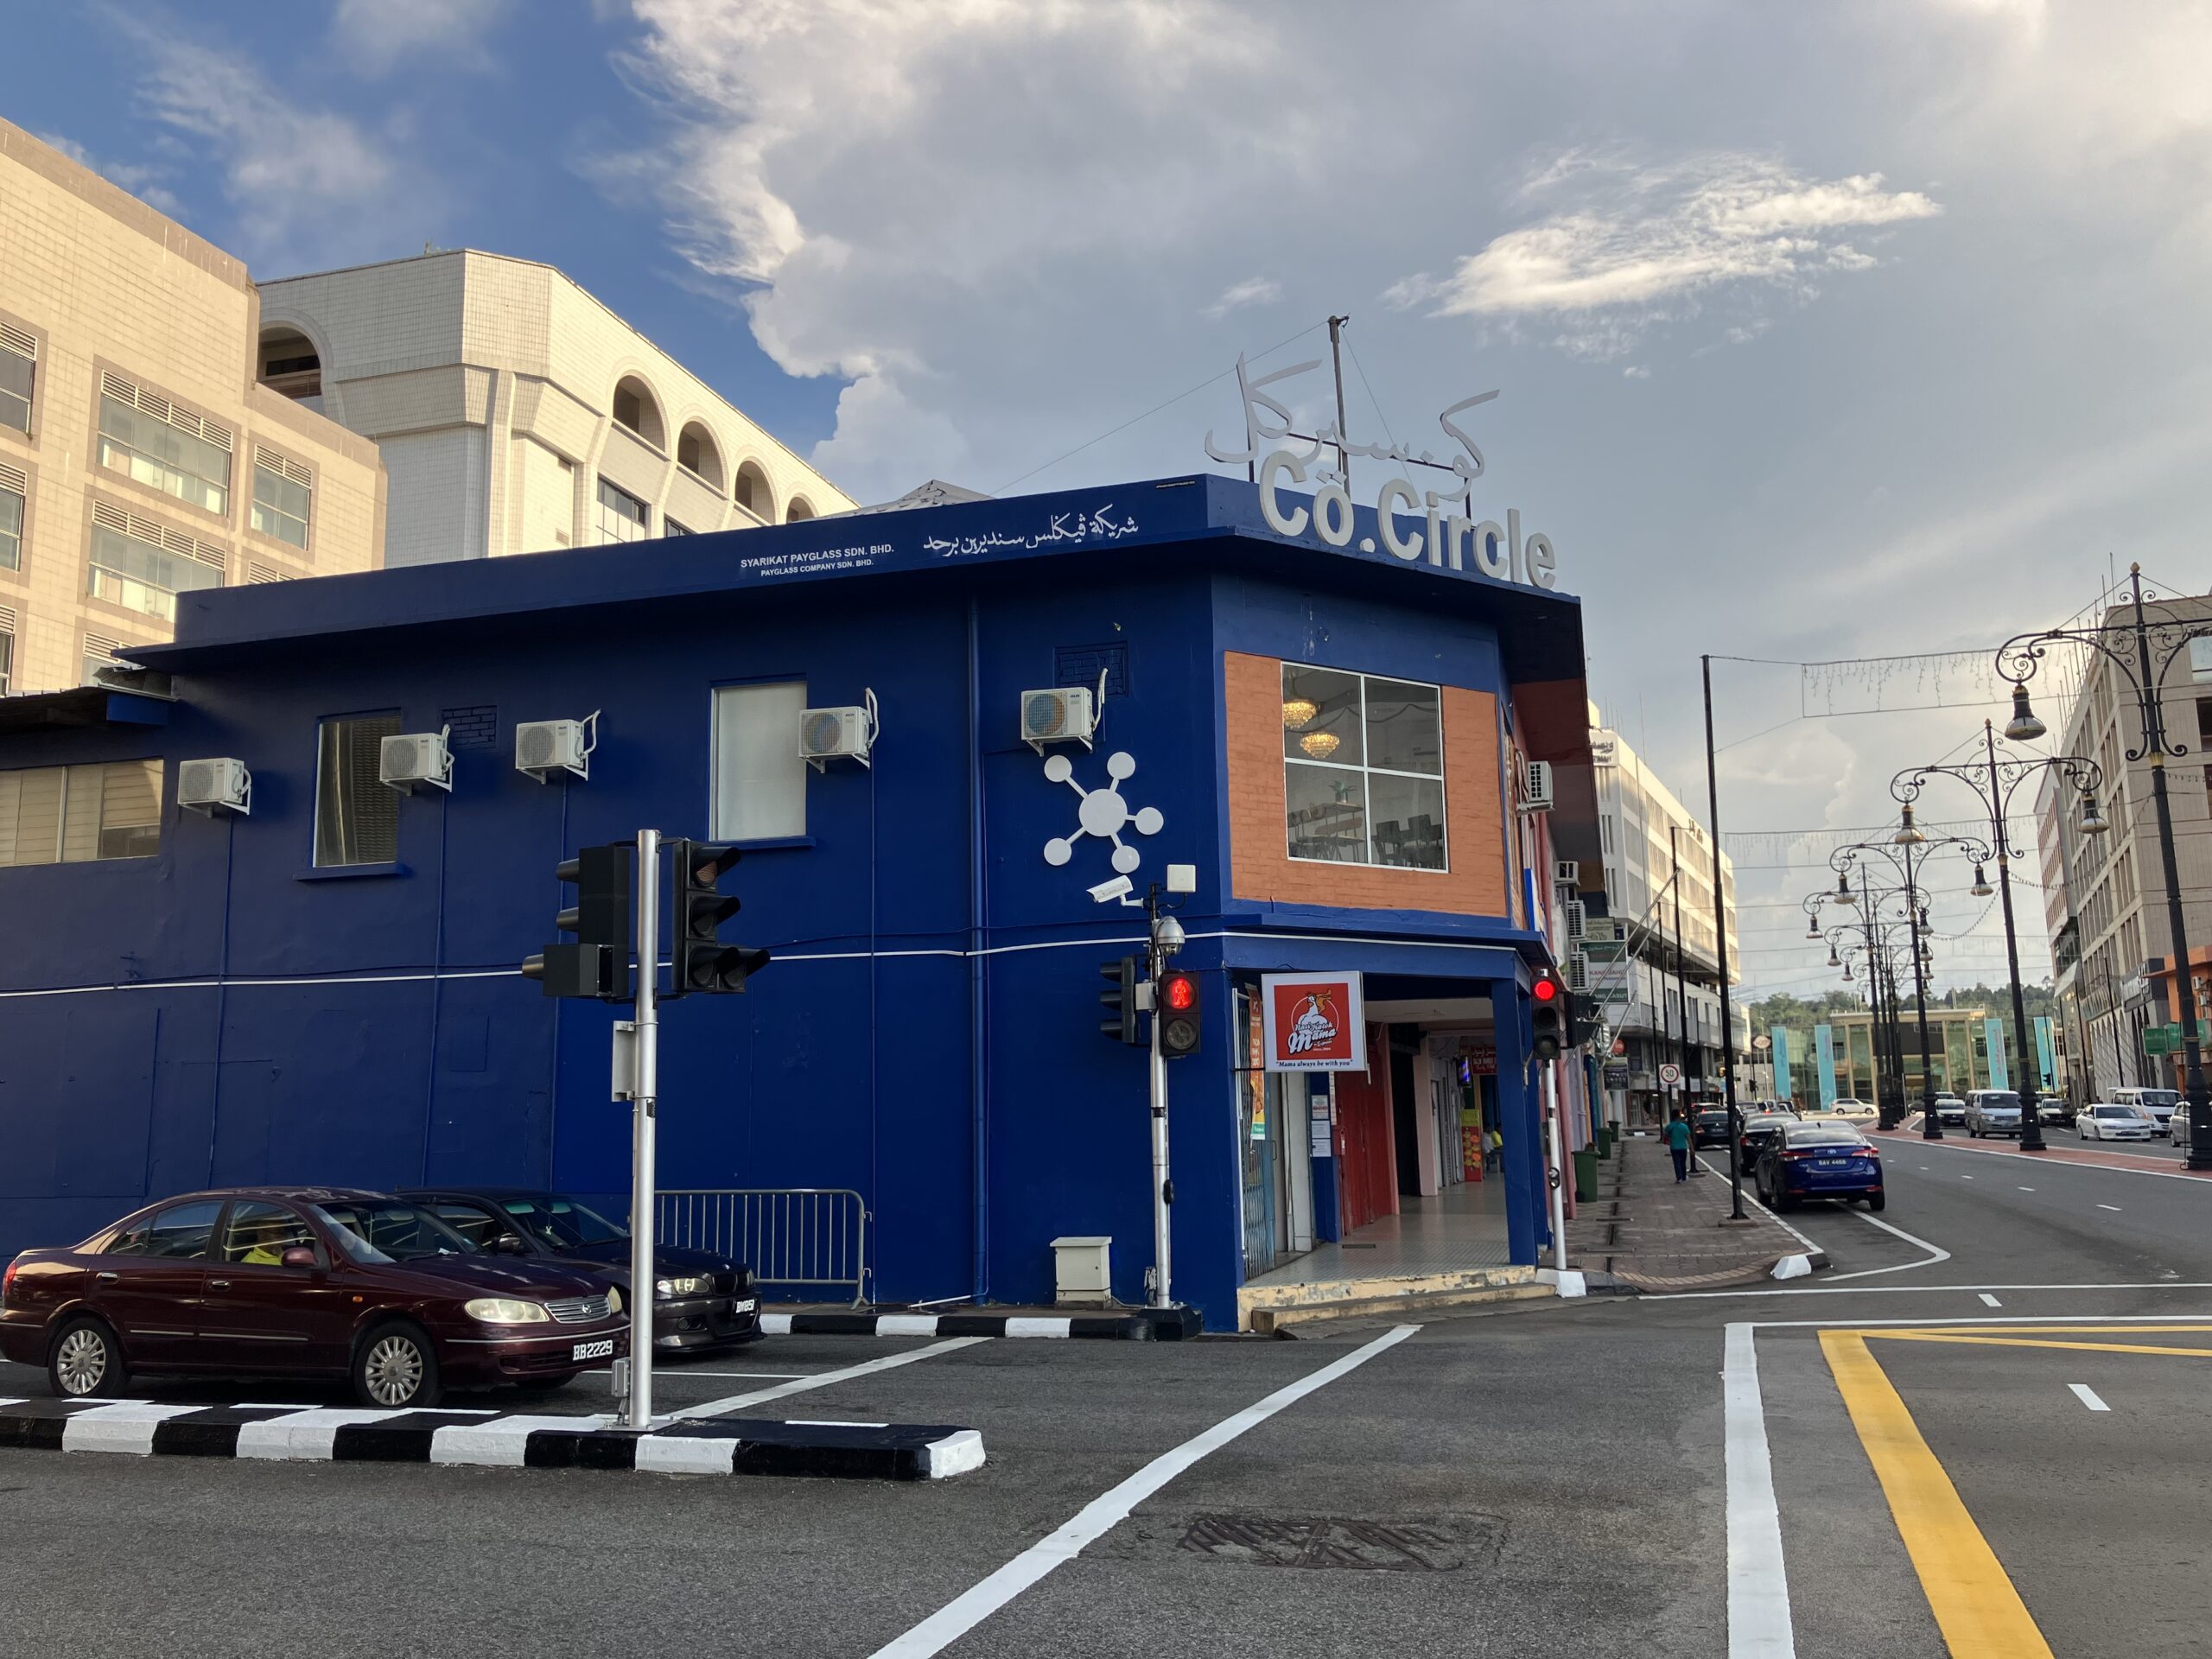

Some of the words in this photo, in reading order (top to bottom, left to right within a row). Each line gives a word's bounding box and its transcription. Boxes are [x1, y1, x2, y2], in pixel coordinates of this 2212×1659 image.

[741, 555, 788, 568] SYARIKAT
[791, 550, 842, 562] PAYGLASS
[844, 547, 868, 557] SDN.
[870, 543, 894, 555] BHD.
[761, 566, 798, 576] PAYGLASS
[800, 563, 836, 573] COMPANY
[1288, 1027, 1337, 1054] Mama
[1665, 1069, 1675, 1077] 50
[572, 1339, 613, 1362] BB2229
